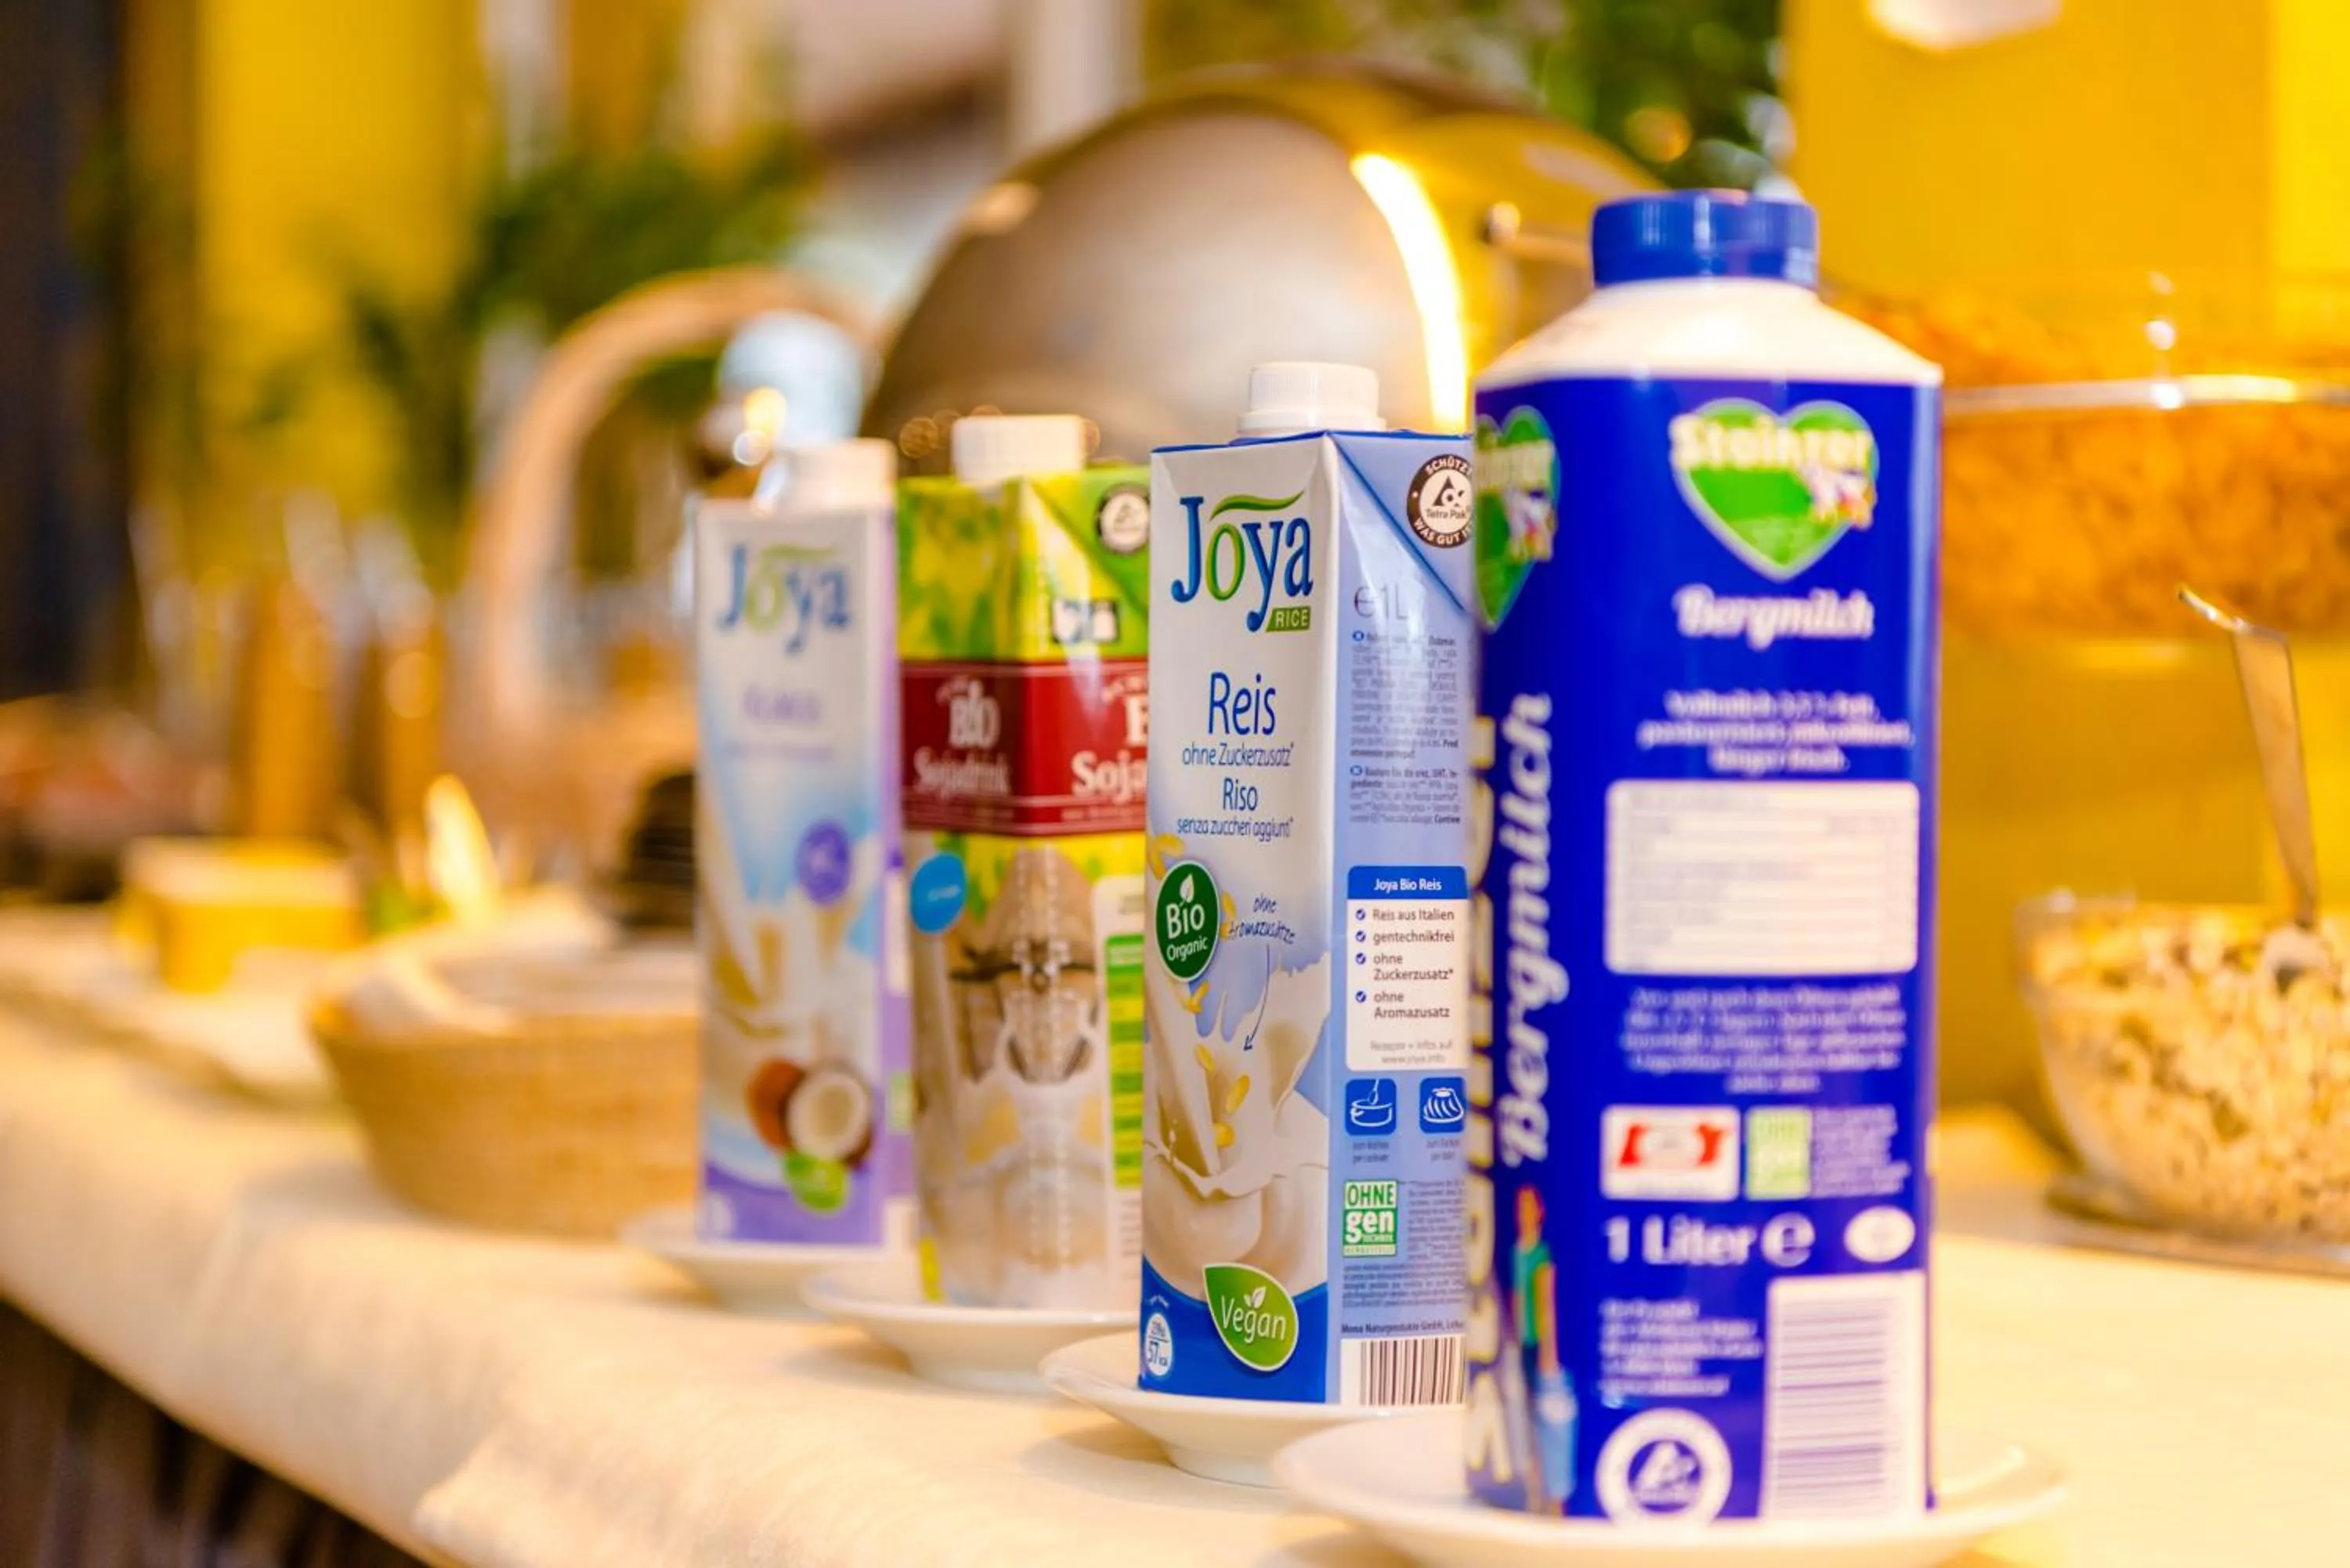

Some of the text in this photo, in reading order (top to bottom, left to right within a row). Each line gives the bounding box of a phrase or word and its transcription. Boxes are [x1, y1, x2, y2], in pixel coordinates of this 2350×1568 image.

[1426, 508, 1448, 518] Tetra
[1414, 518, 1461, 545] WAS GUT
[1171, 497, 1313, 632] Joya
[718, 544, 851, 655] Joya
[1276, 609, 1309, 627] RICE
[1673, 583, 1875, 649] Bergmilch
[1209, 671, 1276, 735] Reis
[1182, 741, 1216, 766] ohne
[1222, 778, 1258, 811] Riso
[1177, 818, 1208, 834] senza
[1374, 878, 1442, 894] Joya Bio Reis
[1253, 894, 1277, 913] ohne
[1372, 908, 1455, 921] Reis aus Italien
[1166, 901, 1205, 939] Bio
[1498, 693, 1568, 1167] Bergmilch
[1166, 936, 1208, 962] Organic
[1372, 930, 1455, 945] gentechnikfrei
[1373, 952, 1403, 964] ohne
[1374, 990, 1404, 1003] ohne
[1374, 1006, 1450, 1018] Aromazusatz
[1348, 1184, 1394, 1206] OHNE
[1345, 1211, 1394, 1244] gen
[1605, 1216, 1629, 1263] 1
[1643, 1213, 1757, 1266] Liter
[1221, 1295, 1286, 1344] Vegan
